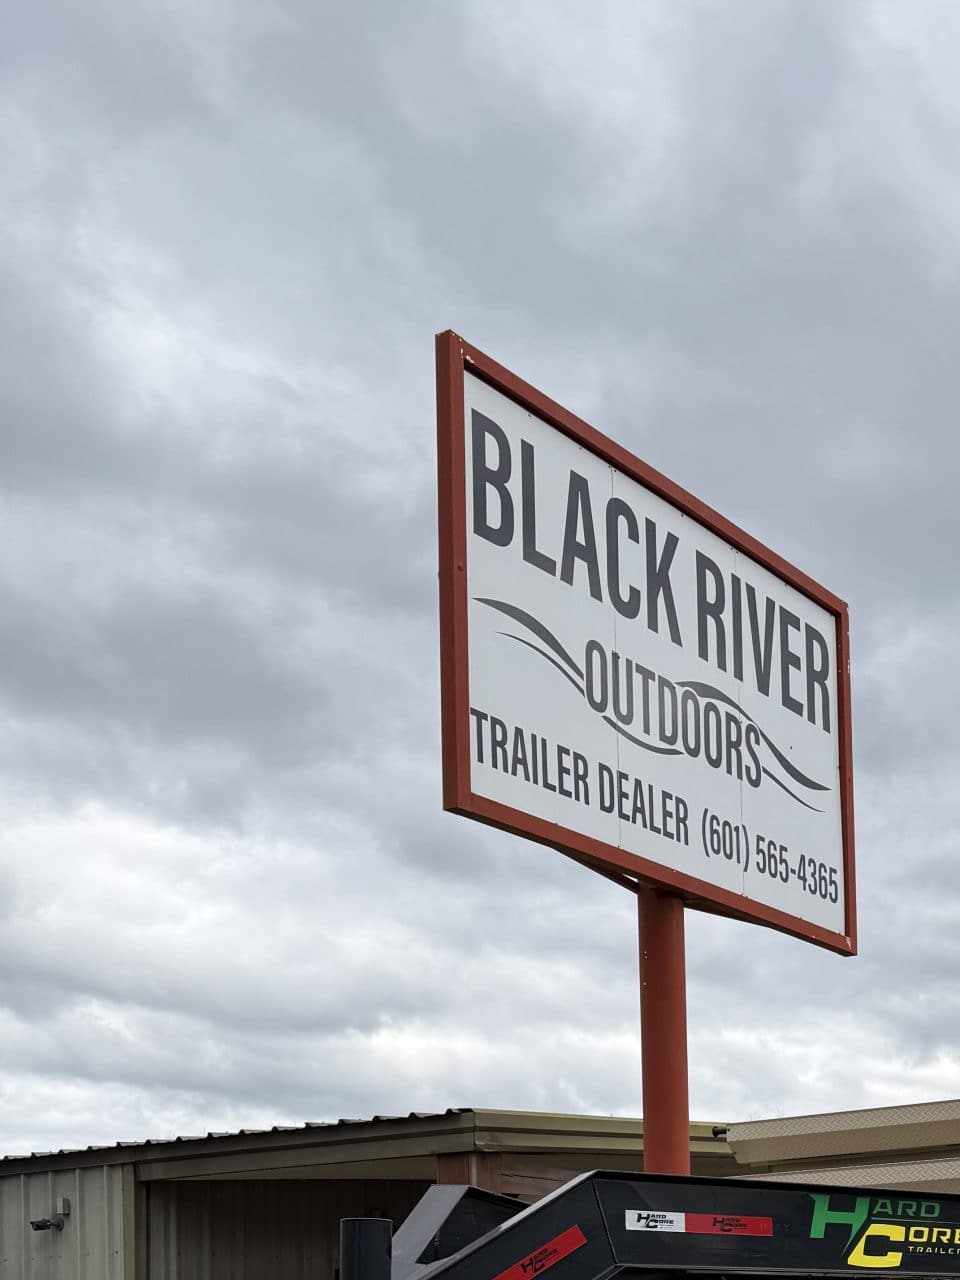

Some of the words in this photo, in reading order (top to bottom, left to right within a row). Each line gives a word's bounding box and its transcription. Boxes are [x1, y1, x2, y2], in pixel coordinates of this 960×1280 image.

[471, 408, 683, 648] BLACK
[696, 549, 832, 734] RIVER
[584, 639, 763, 789] OUTDOORS
[470, 708, 590, 806] TRAILER
[598, 762, 690, 846] DEALER
[701, 807, 750, 873] (601)
[756, 835, 839, 904] 565-4365
[808, 1193, 941, 1239] HARD
